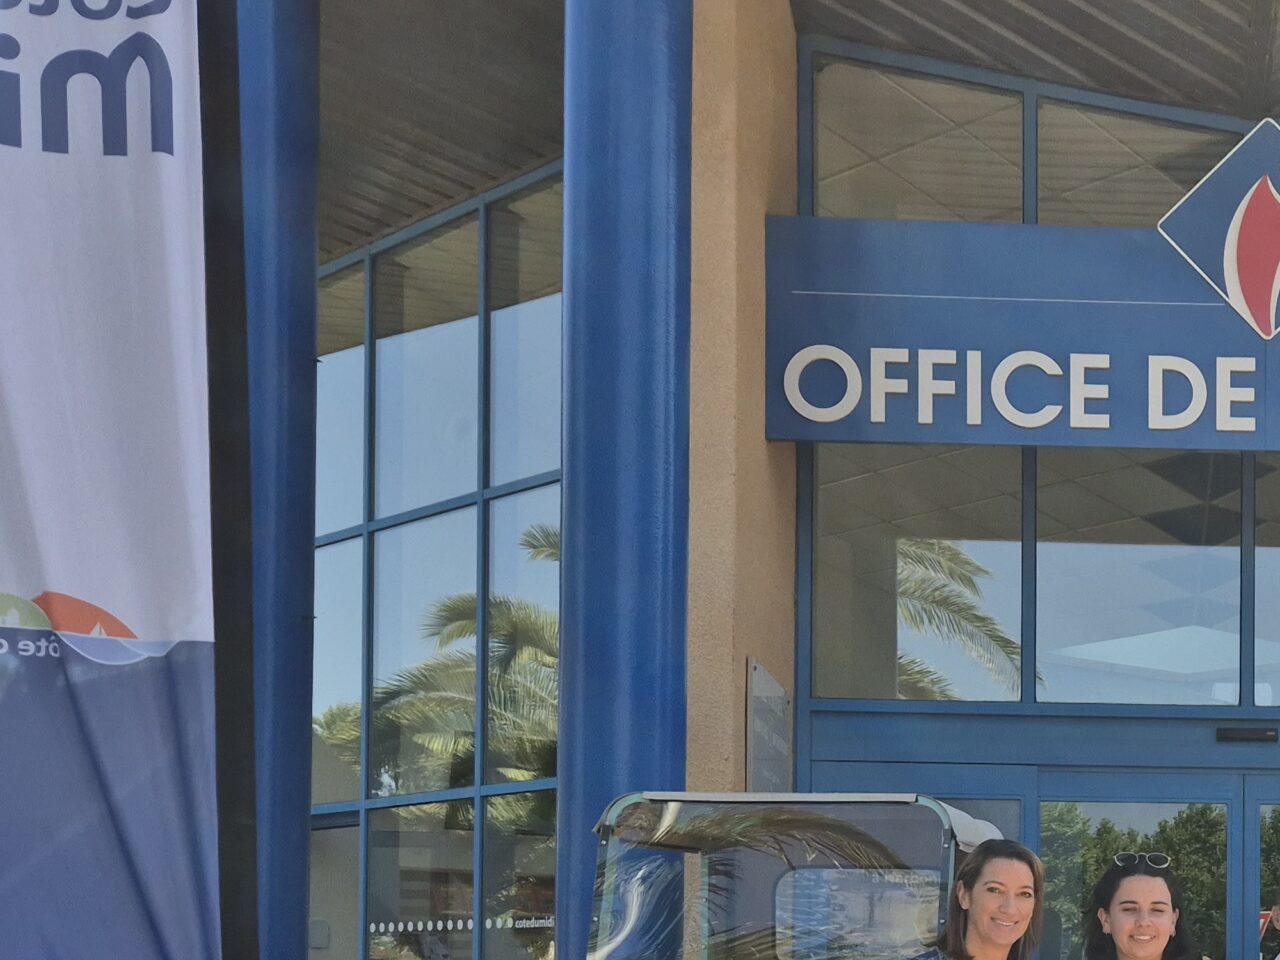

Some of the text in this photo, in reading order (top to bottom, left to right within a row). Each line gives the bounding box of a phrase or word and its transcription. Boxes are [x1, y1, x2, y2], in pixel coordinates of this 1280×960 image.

[783, 344, 1110, 430] OFFICE
[1147, 354, 1256, 432] DE
[515, 916, 555, 929] cotedumidi
